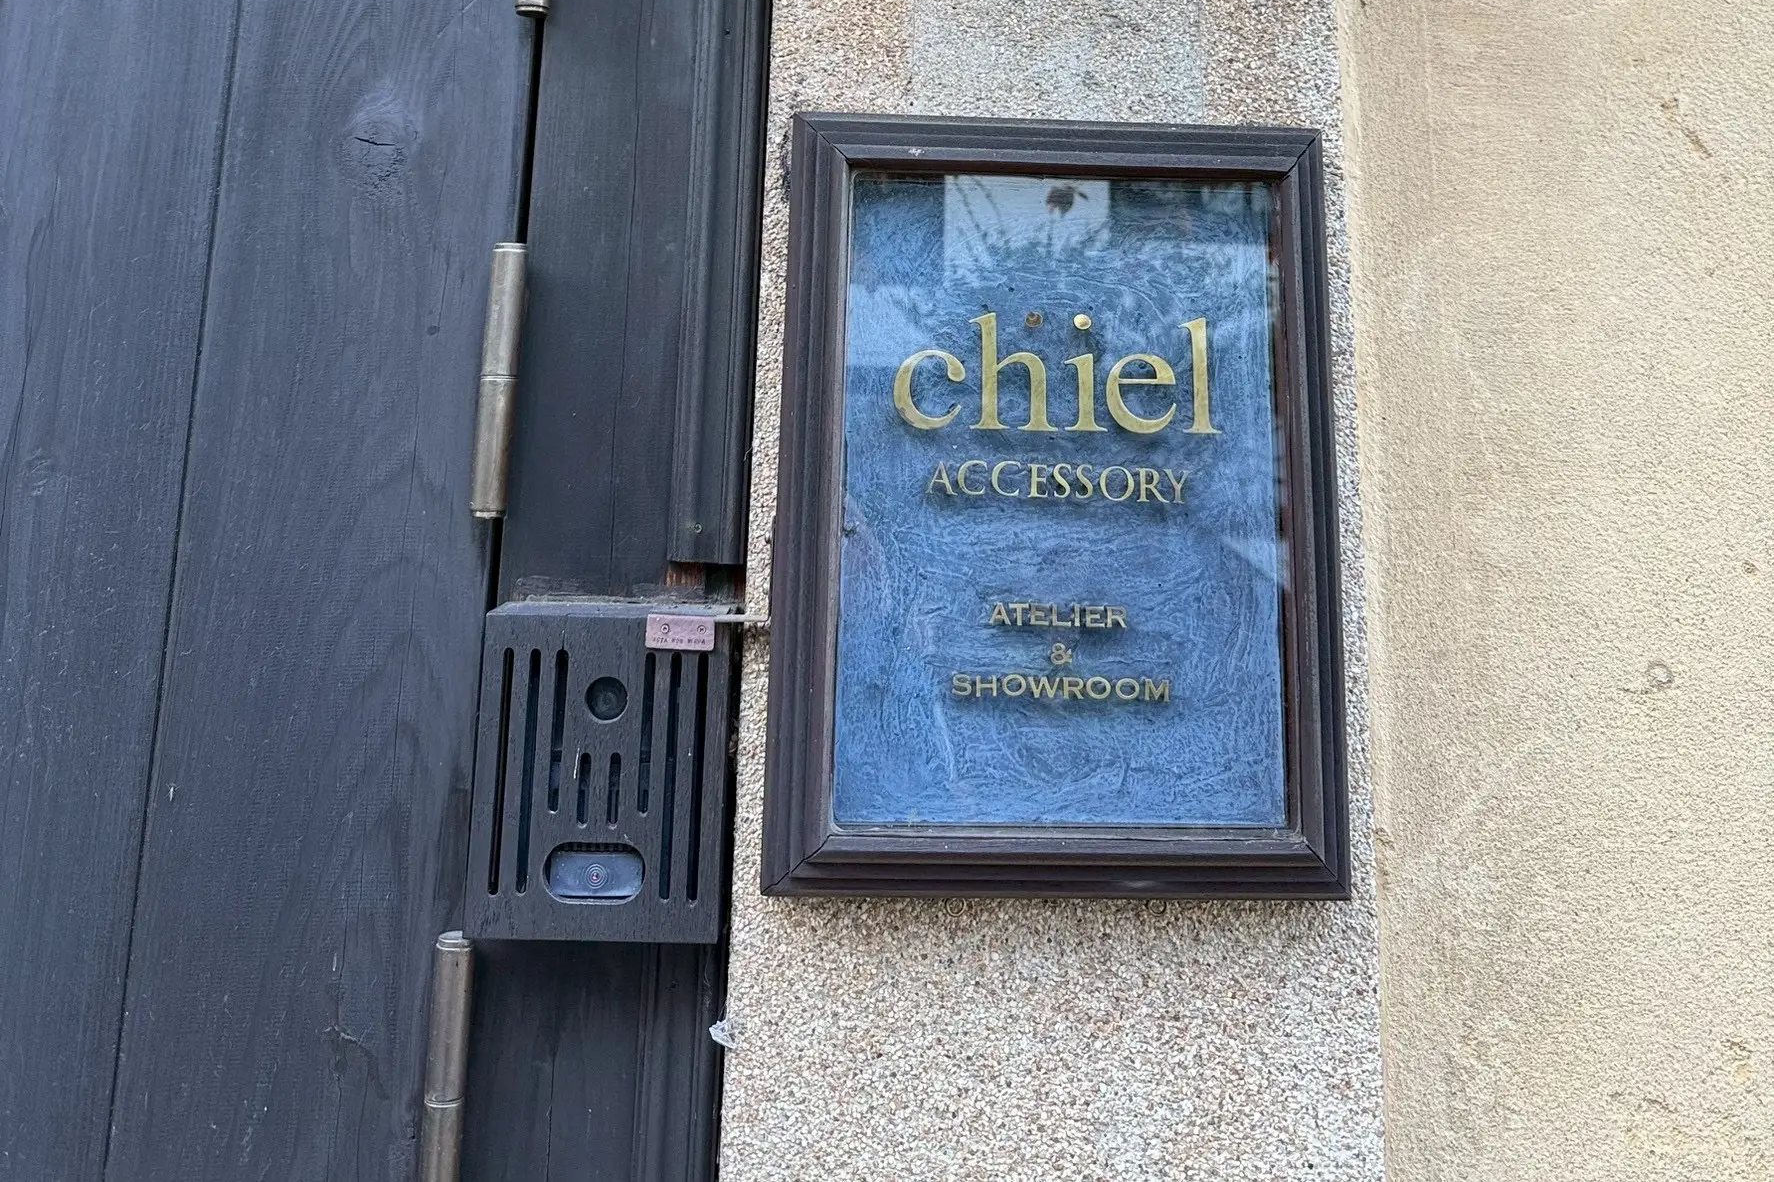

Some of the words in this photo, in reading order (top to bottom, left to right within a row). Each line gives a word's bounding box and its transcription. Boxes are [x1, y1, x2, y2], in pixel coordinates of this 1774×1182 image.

[893, 312, 1222, 434] chiel
[926, 460, 1192, 504] ACCESSORY
[988, 602, 1127, 629] ATELIER
[1050, 642, 1073, 665] &
[951, 673, 1171, 702] SHOWROOM
